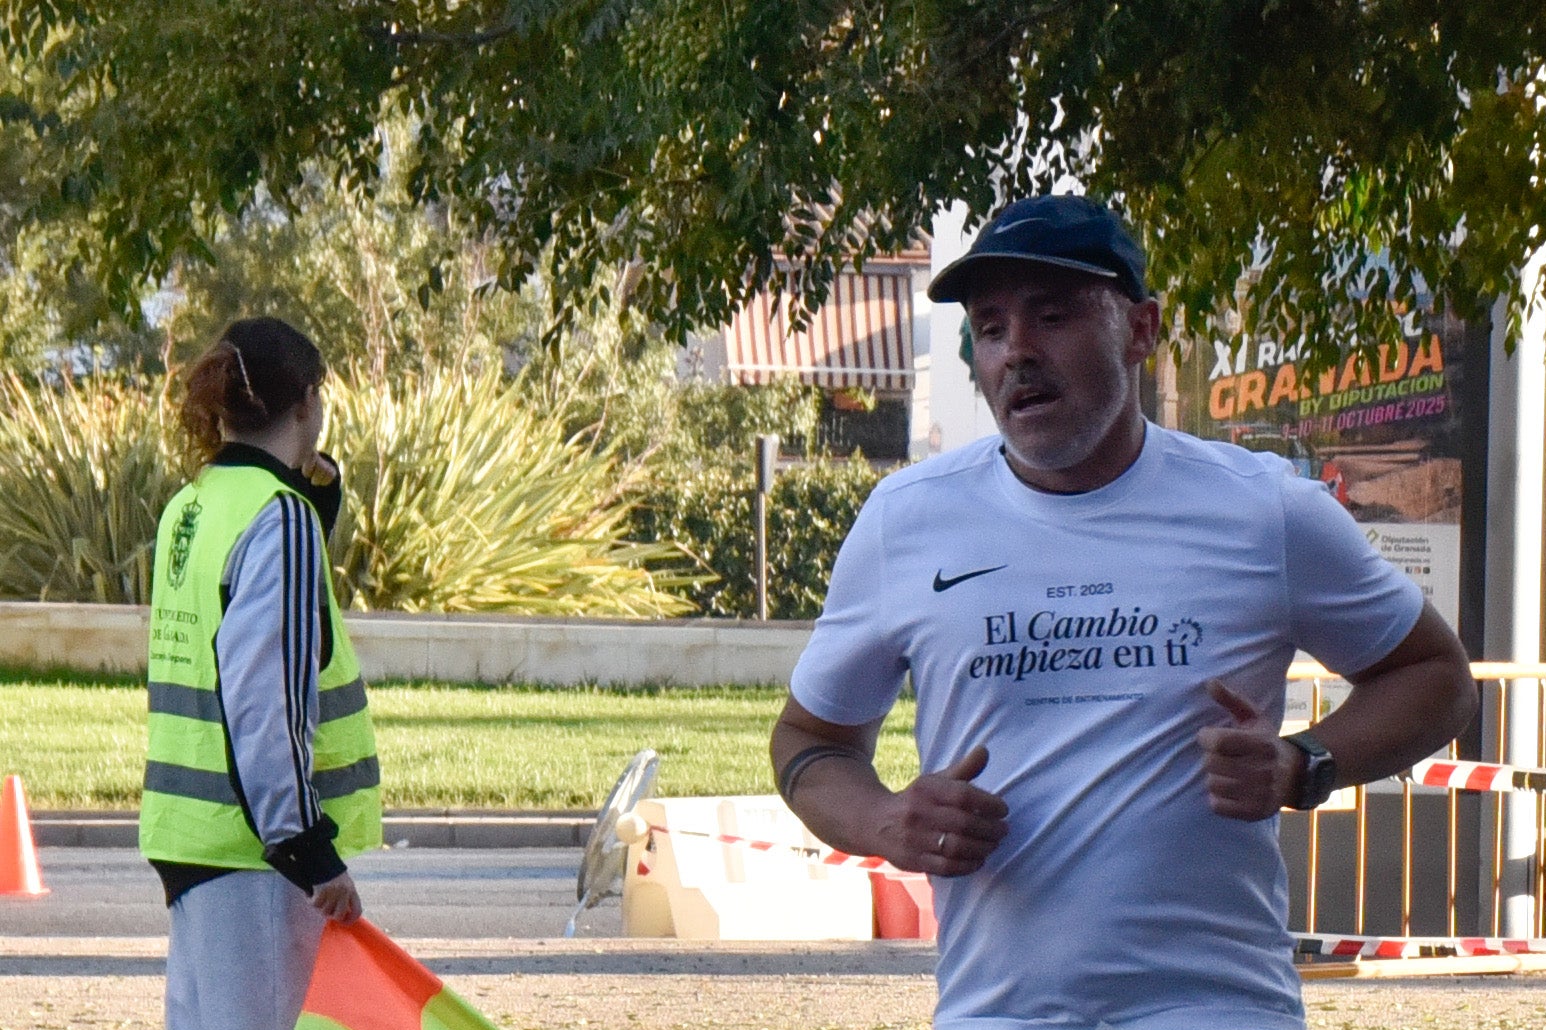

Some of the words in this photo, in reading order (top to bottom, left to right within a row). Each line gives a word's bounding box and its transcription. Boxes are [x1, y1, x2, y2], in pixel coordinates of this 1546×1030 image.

[1300, 397, 1324, 416] BY
[1336, 401, 1404, 431] OCTUBRE
[1406, 395, 1447, 417] 2025
[1046, 586, 1077, 598] EST.
[1080, 582, 1114, 597] 2023
[984, 611, 1019, 646] El
[1028, 607, 1159, 641] Cambio
[969, 641, 1103, 682] empieza
[1113, 644, 1156, 668] en
[1163, 633, 1190, 667] tí
[1024, 697, 1060, 706] CENTRO
[1062, 696, 1073, 704] DE
[1075, 692, 1144, 704] ENTRENAMIENTO
